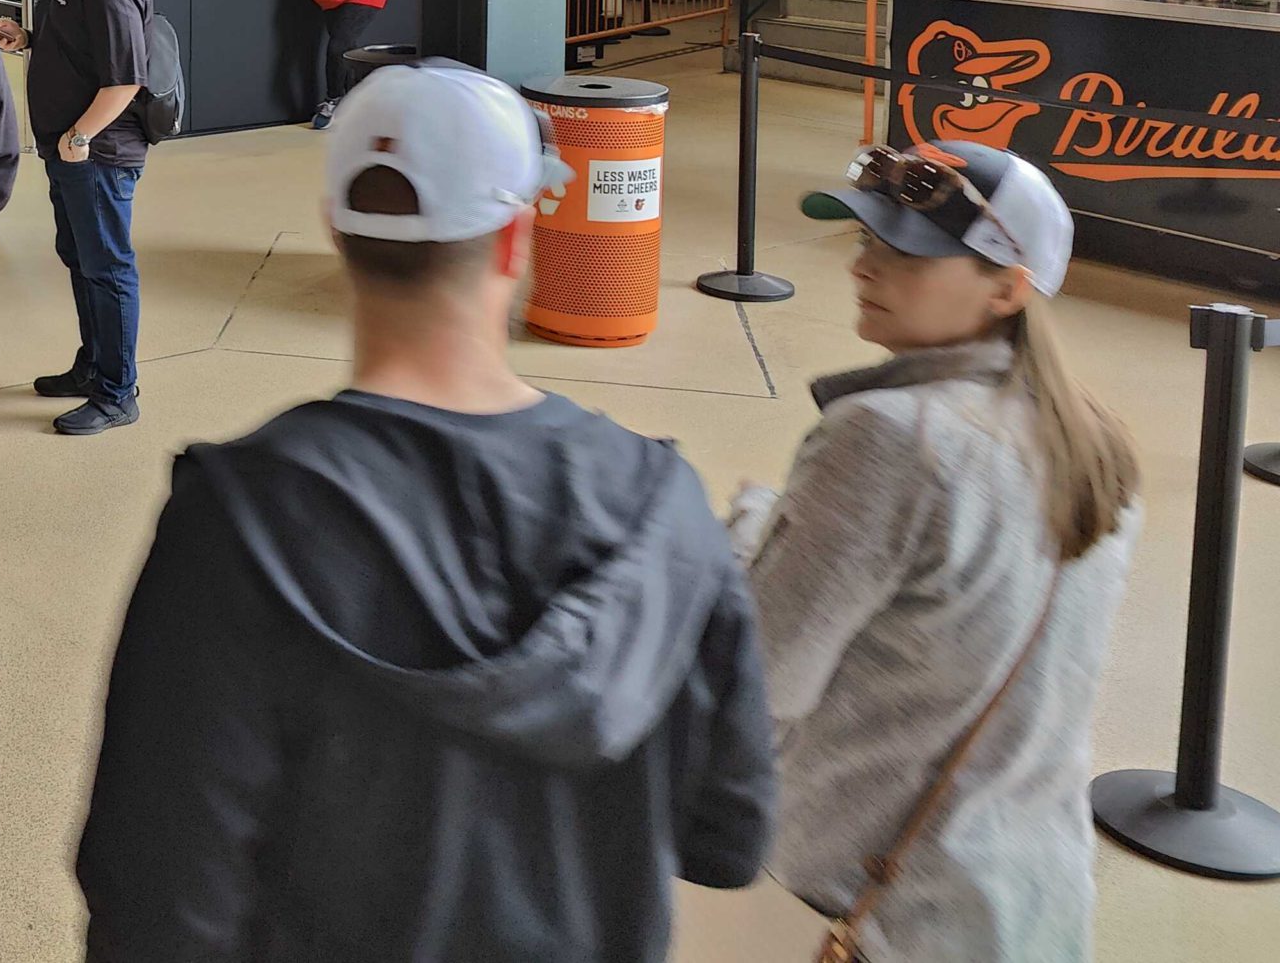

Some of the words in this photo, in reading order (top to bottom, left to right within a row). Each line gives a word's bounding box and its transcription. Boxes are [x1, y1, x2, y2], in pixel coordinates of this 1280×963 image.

[550, 104, 575, 119] CANS
[597, 170, 624, 182] LESS
[627, 168, 657, 182] WASTE
[593, 183, 624, 194] MORE
